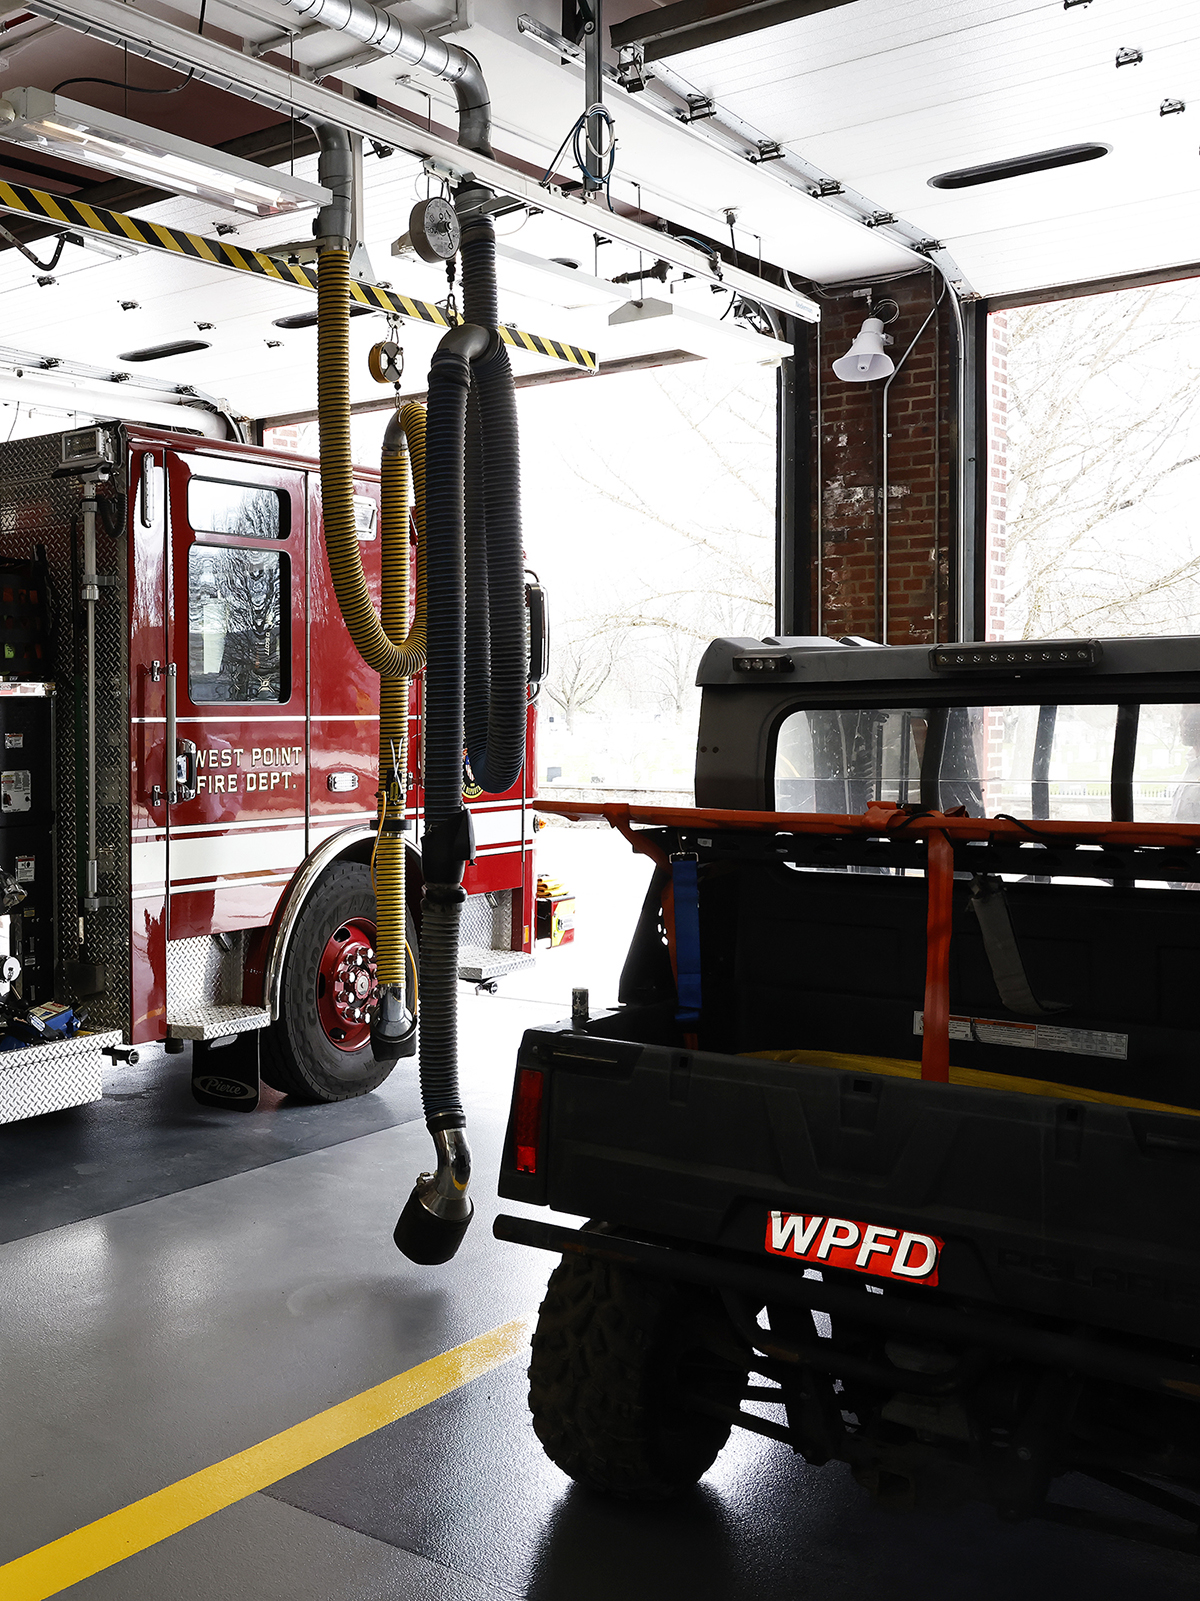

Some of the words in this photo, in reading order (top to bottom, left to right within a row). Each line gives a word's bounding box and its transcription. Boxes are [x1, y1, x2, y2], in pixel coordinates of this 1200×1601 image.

[195, 749, 244, 769] WEST
[251, 747, 303, 767] POINT
[196, 774, 238, 795] FIRE
[246, 772, 297, 793] DEPT.
[205, 1078, 242, 1095] Pierce
[770, 1210, 940, 1279] WPFD
